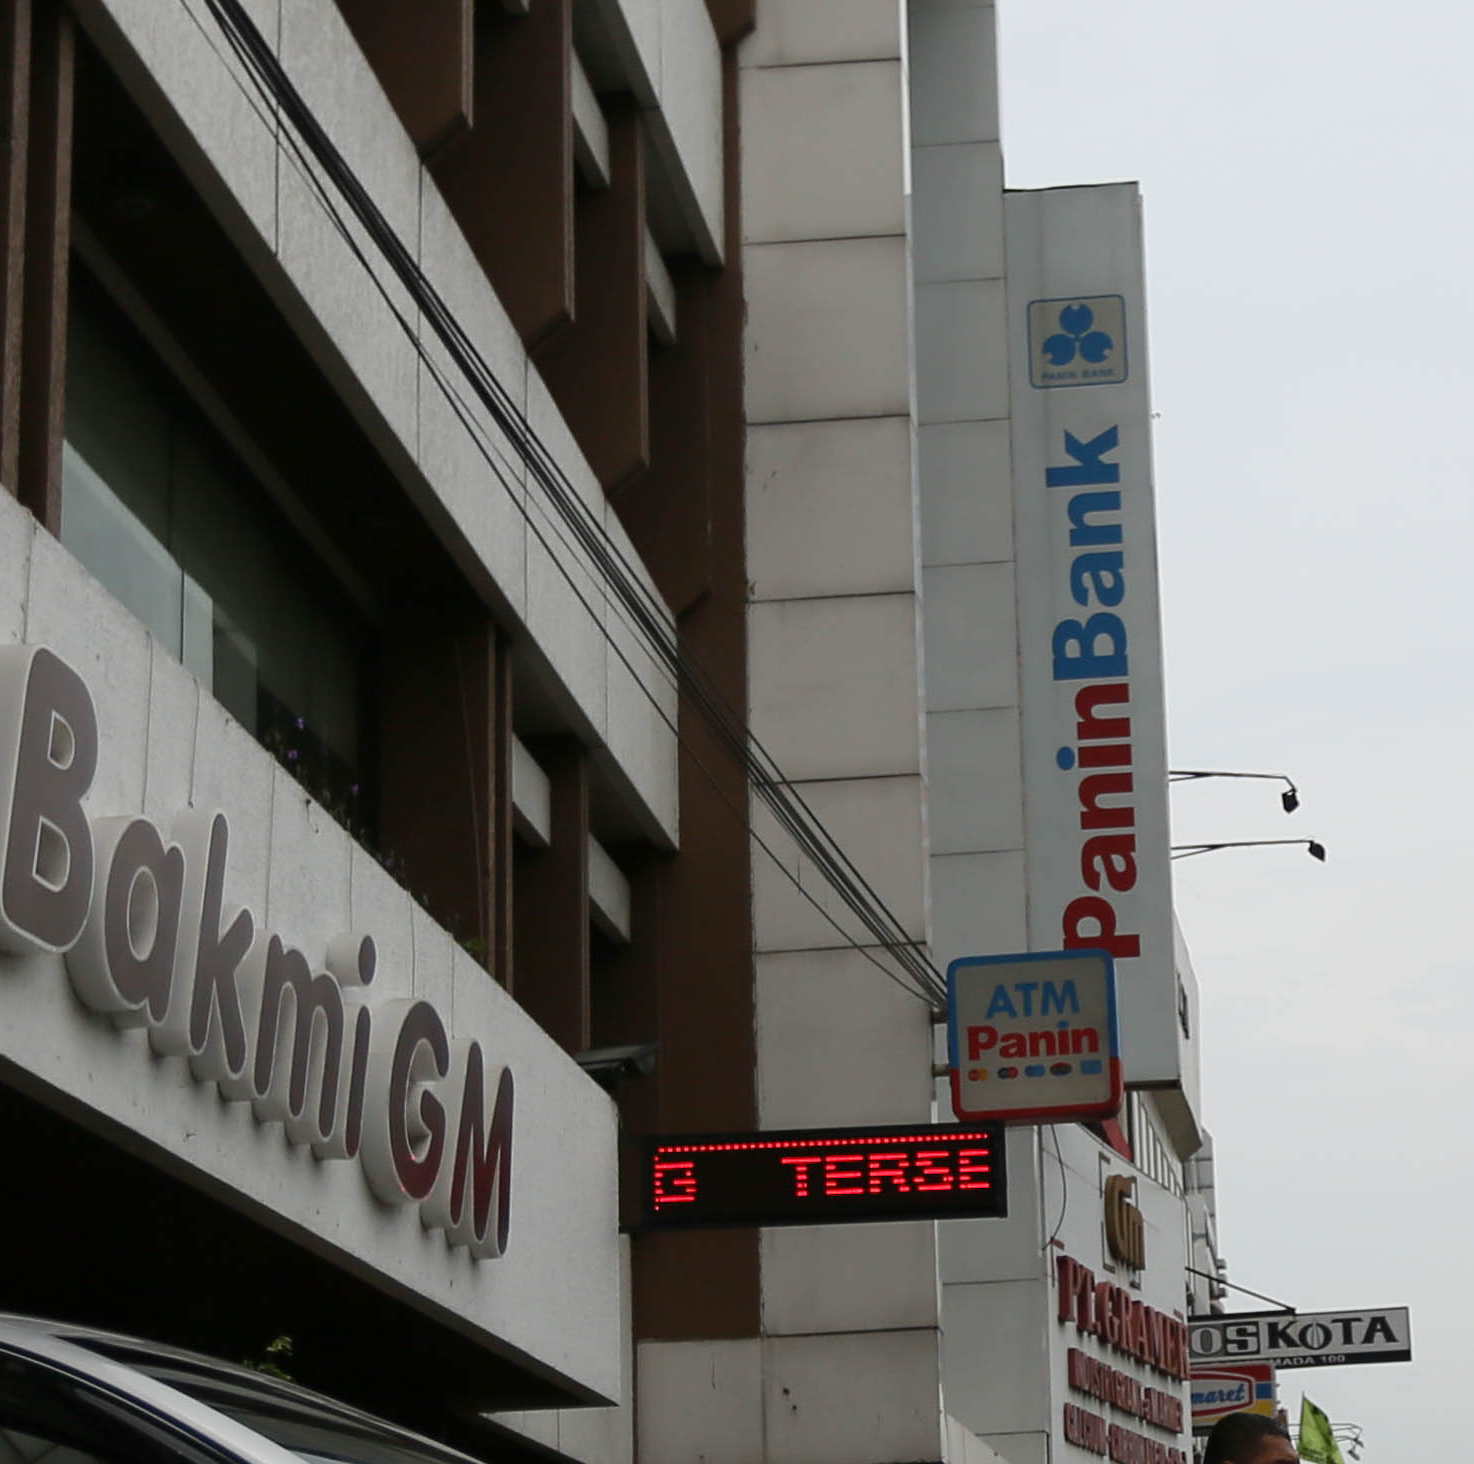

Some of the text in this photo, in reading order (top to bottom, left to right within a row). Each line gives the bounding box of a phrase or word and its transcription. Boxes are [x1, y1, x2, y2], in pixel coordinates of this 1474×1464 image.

[985, 979, 1081, 1020] ATM
[966, 1019, 1101, 1062] Panin
[781, 1150, 990, 1197] TERSE
[1268, 1316, 1398, 1351] KOTA
